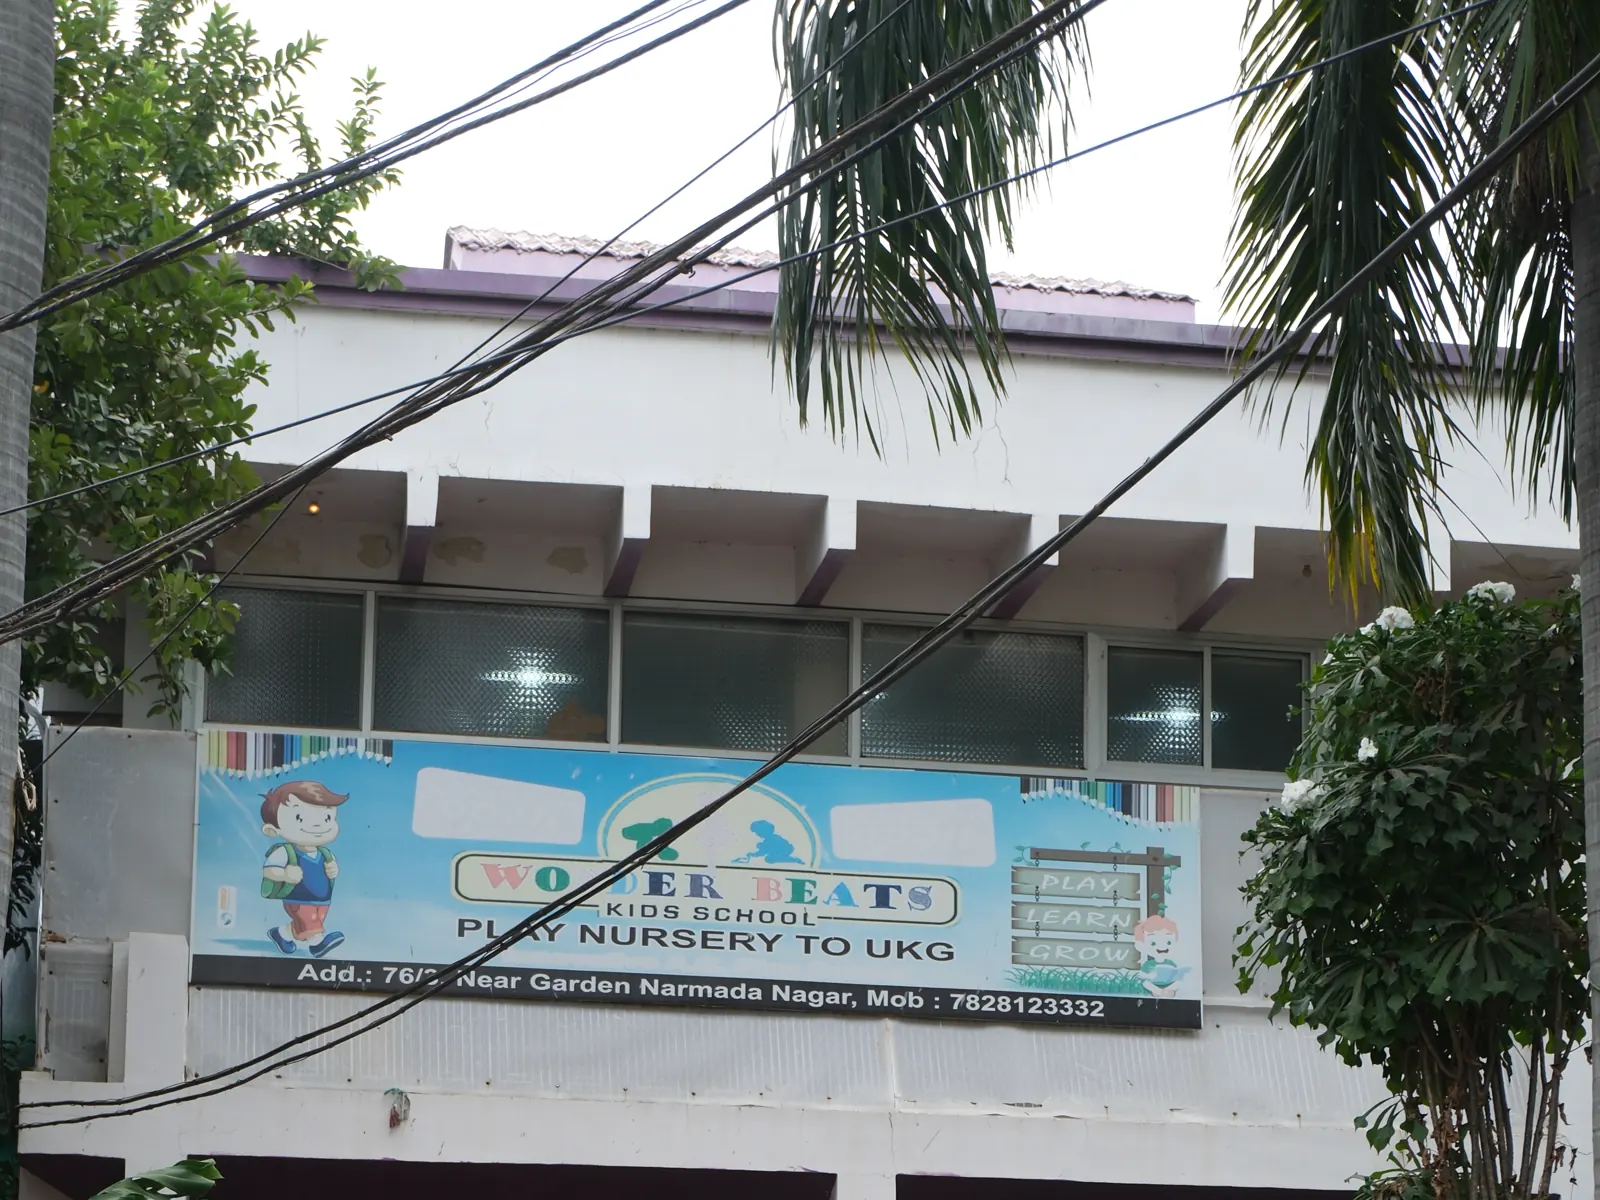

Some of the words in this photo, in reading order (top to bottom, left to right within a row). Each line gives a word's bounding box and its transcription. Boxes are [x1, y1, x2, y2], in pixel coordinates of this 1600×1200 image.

[751, 876, 932, 912] BEATS
[1041, 874, 1119, 892] PLAY
[606, 902, 680, 919] KIDS
[693, 906, 816, 927] SCHOOL
[1026, 908, 1132, 928] LEARN
[579, 924, 783, 952] NURSERY
[796, 934, 851, 957] TO
[866, 938, 955, 962] UKG
[1029, 944, 1129, 961] GROW
[456, 970, 522, 990] Near
[529, 973, 630, 995] Garden
[640, 978, 763, 1001] Narmada
[771, 984, 857, 1008] Nagar,
[867, 989, 924, 1009] Mob
[950, 993, 1105, 1017] 7828123332
